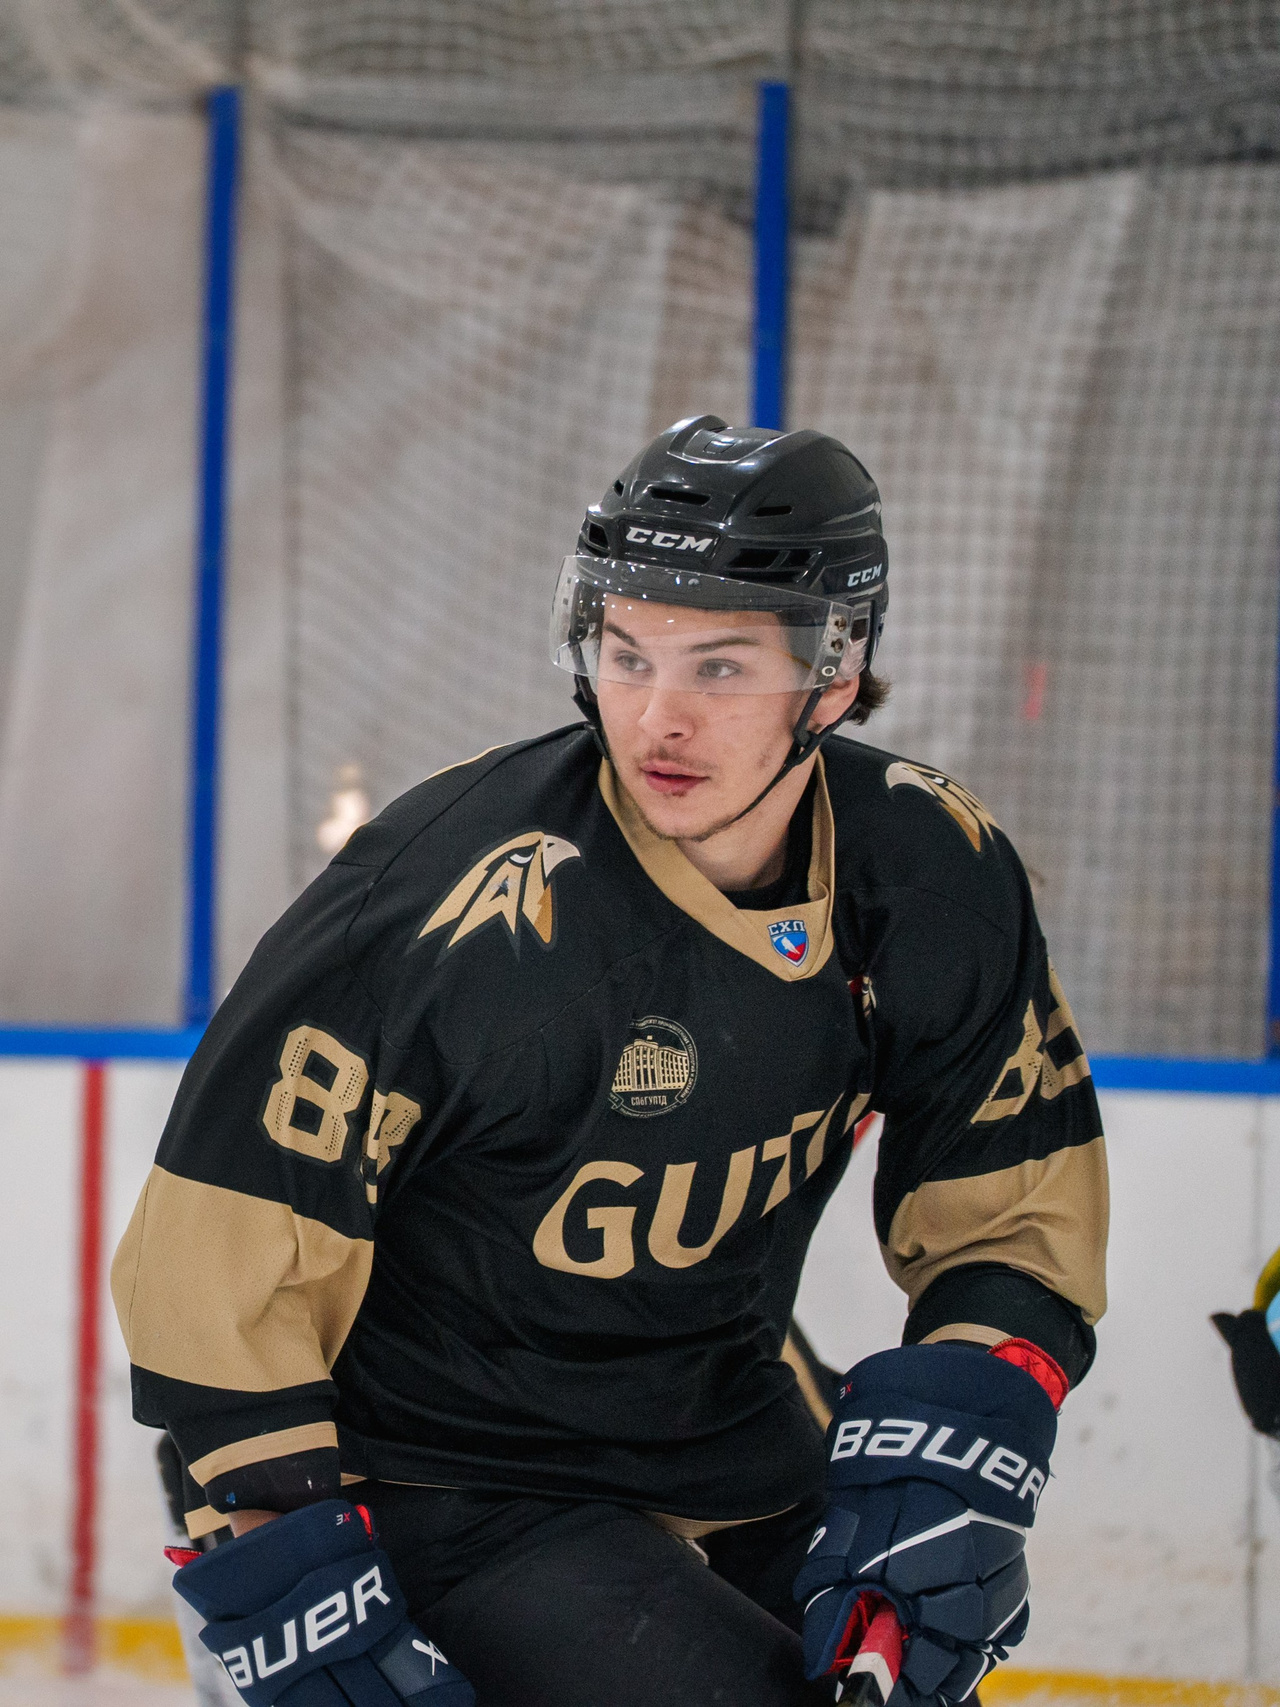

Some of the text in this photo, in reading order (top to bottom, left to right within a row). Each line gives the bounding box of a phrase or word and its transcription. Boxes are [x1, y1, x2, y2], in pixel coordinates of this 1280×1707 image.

[625, 526, 714, 552] CCM
[847, 563, 882, 587] CCM
[532, 1090, 872, 1279] GUT
[222, 1565, 391, 1689] AUER
